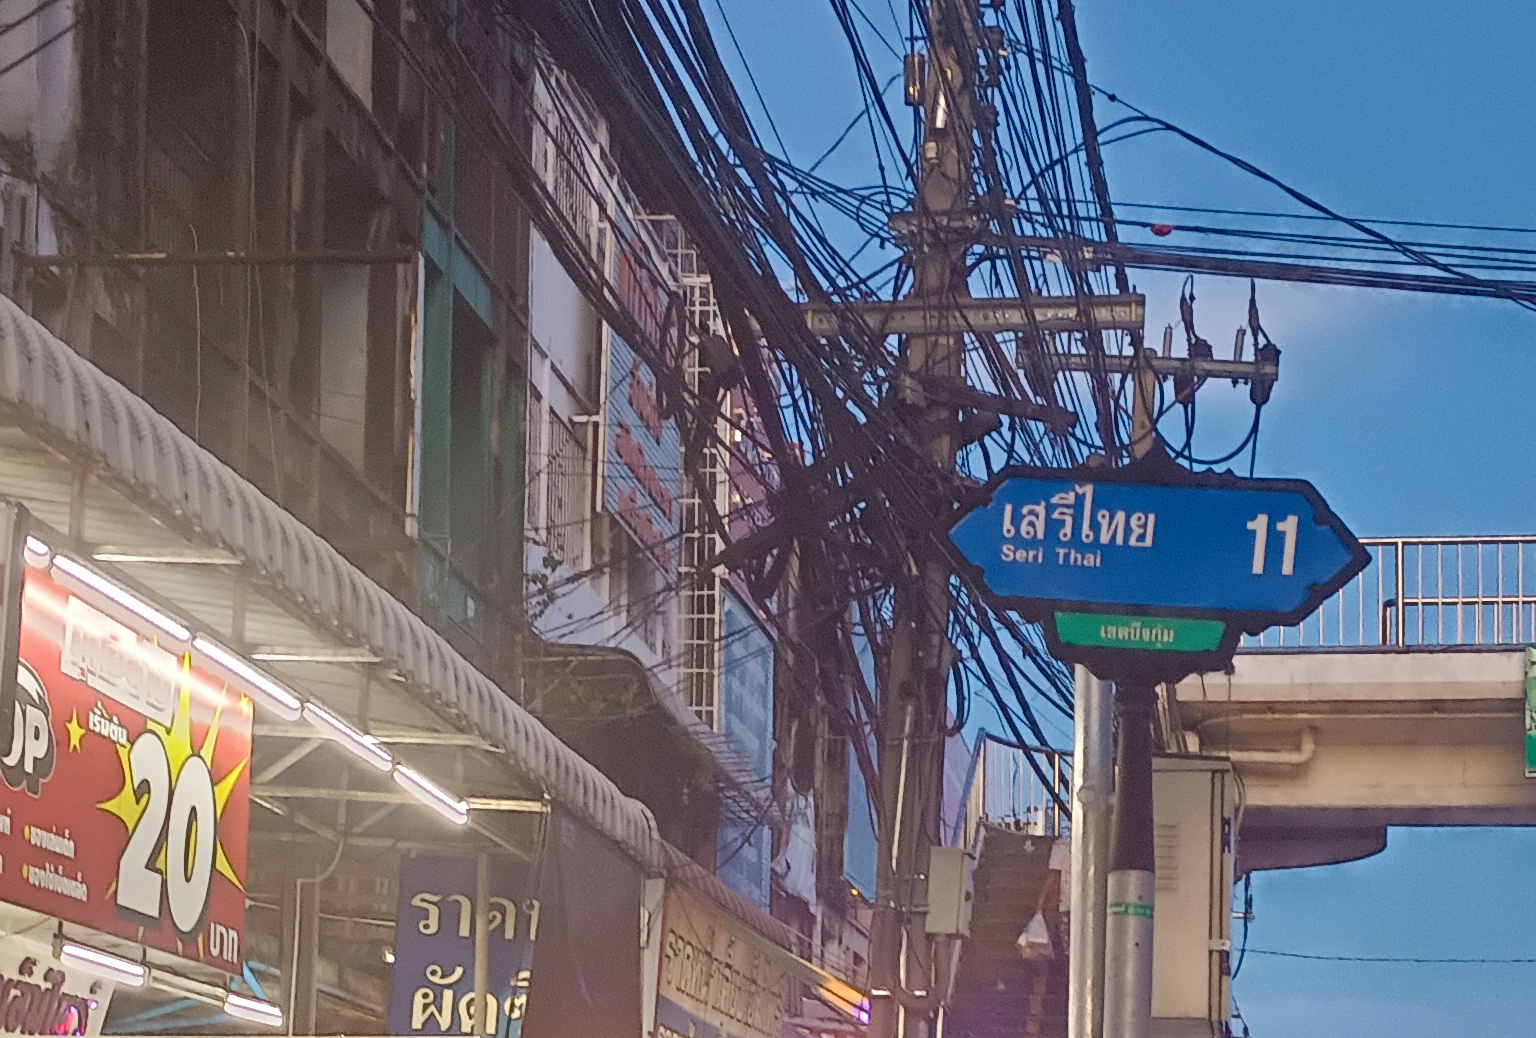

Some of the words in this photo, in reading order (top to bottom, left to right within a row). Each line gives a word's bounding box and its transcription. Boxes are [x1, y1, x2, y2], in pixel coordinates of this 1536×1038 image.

[1002, 484, 1156, 547] เสรีไทย
[1246, 513, 1299, 575] 11
[1001, 545, 1043, 564] Seri
[1055, 547, 1101, 568] Thai
[1100, 621, 1175, 648] เขตบึงกุ่ม
[116, 729, 215, 935] 20
[209, 921, 239, 964] บาท
